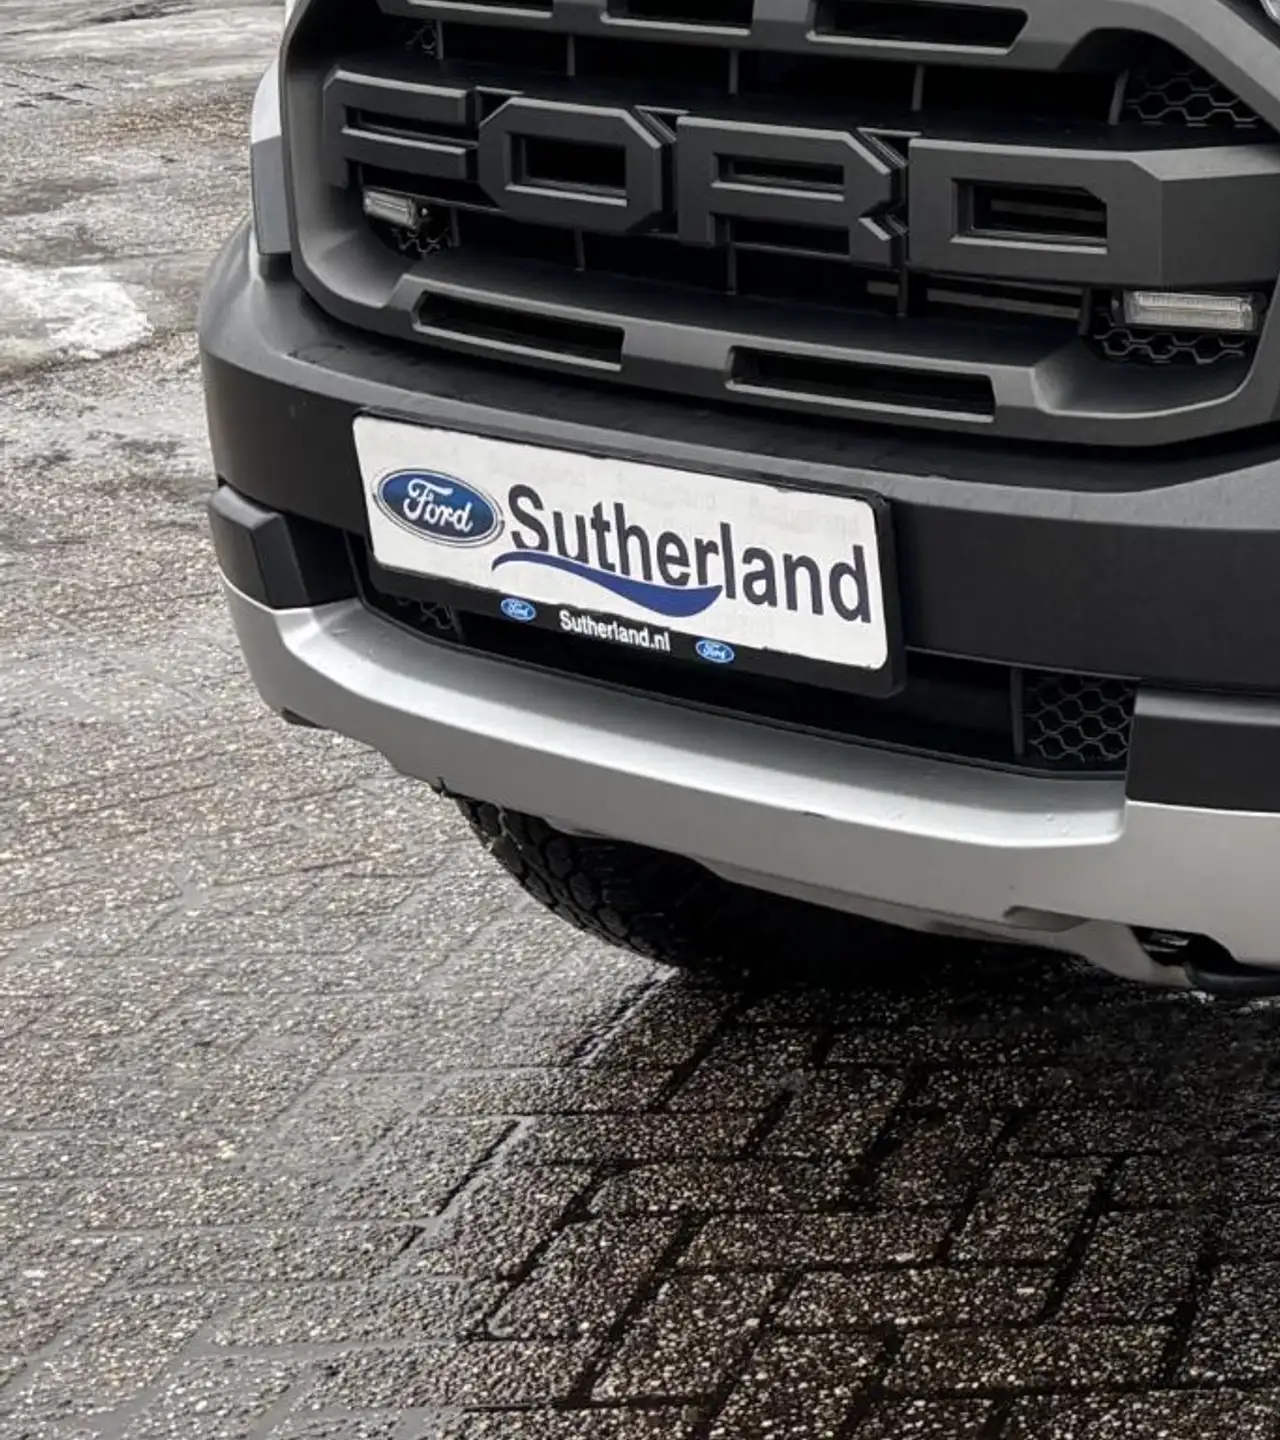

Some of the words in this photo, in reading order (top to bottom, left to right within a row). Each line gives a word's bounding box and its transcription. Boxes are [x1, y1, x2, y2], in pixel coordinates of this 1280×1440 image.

[323, 66, 1166, 286] FORD
[403, 477, 475, 533] Ford
[507, 483, 872, 624] Sutherland
[559, 609, 671, 652] Sutherland.nl
